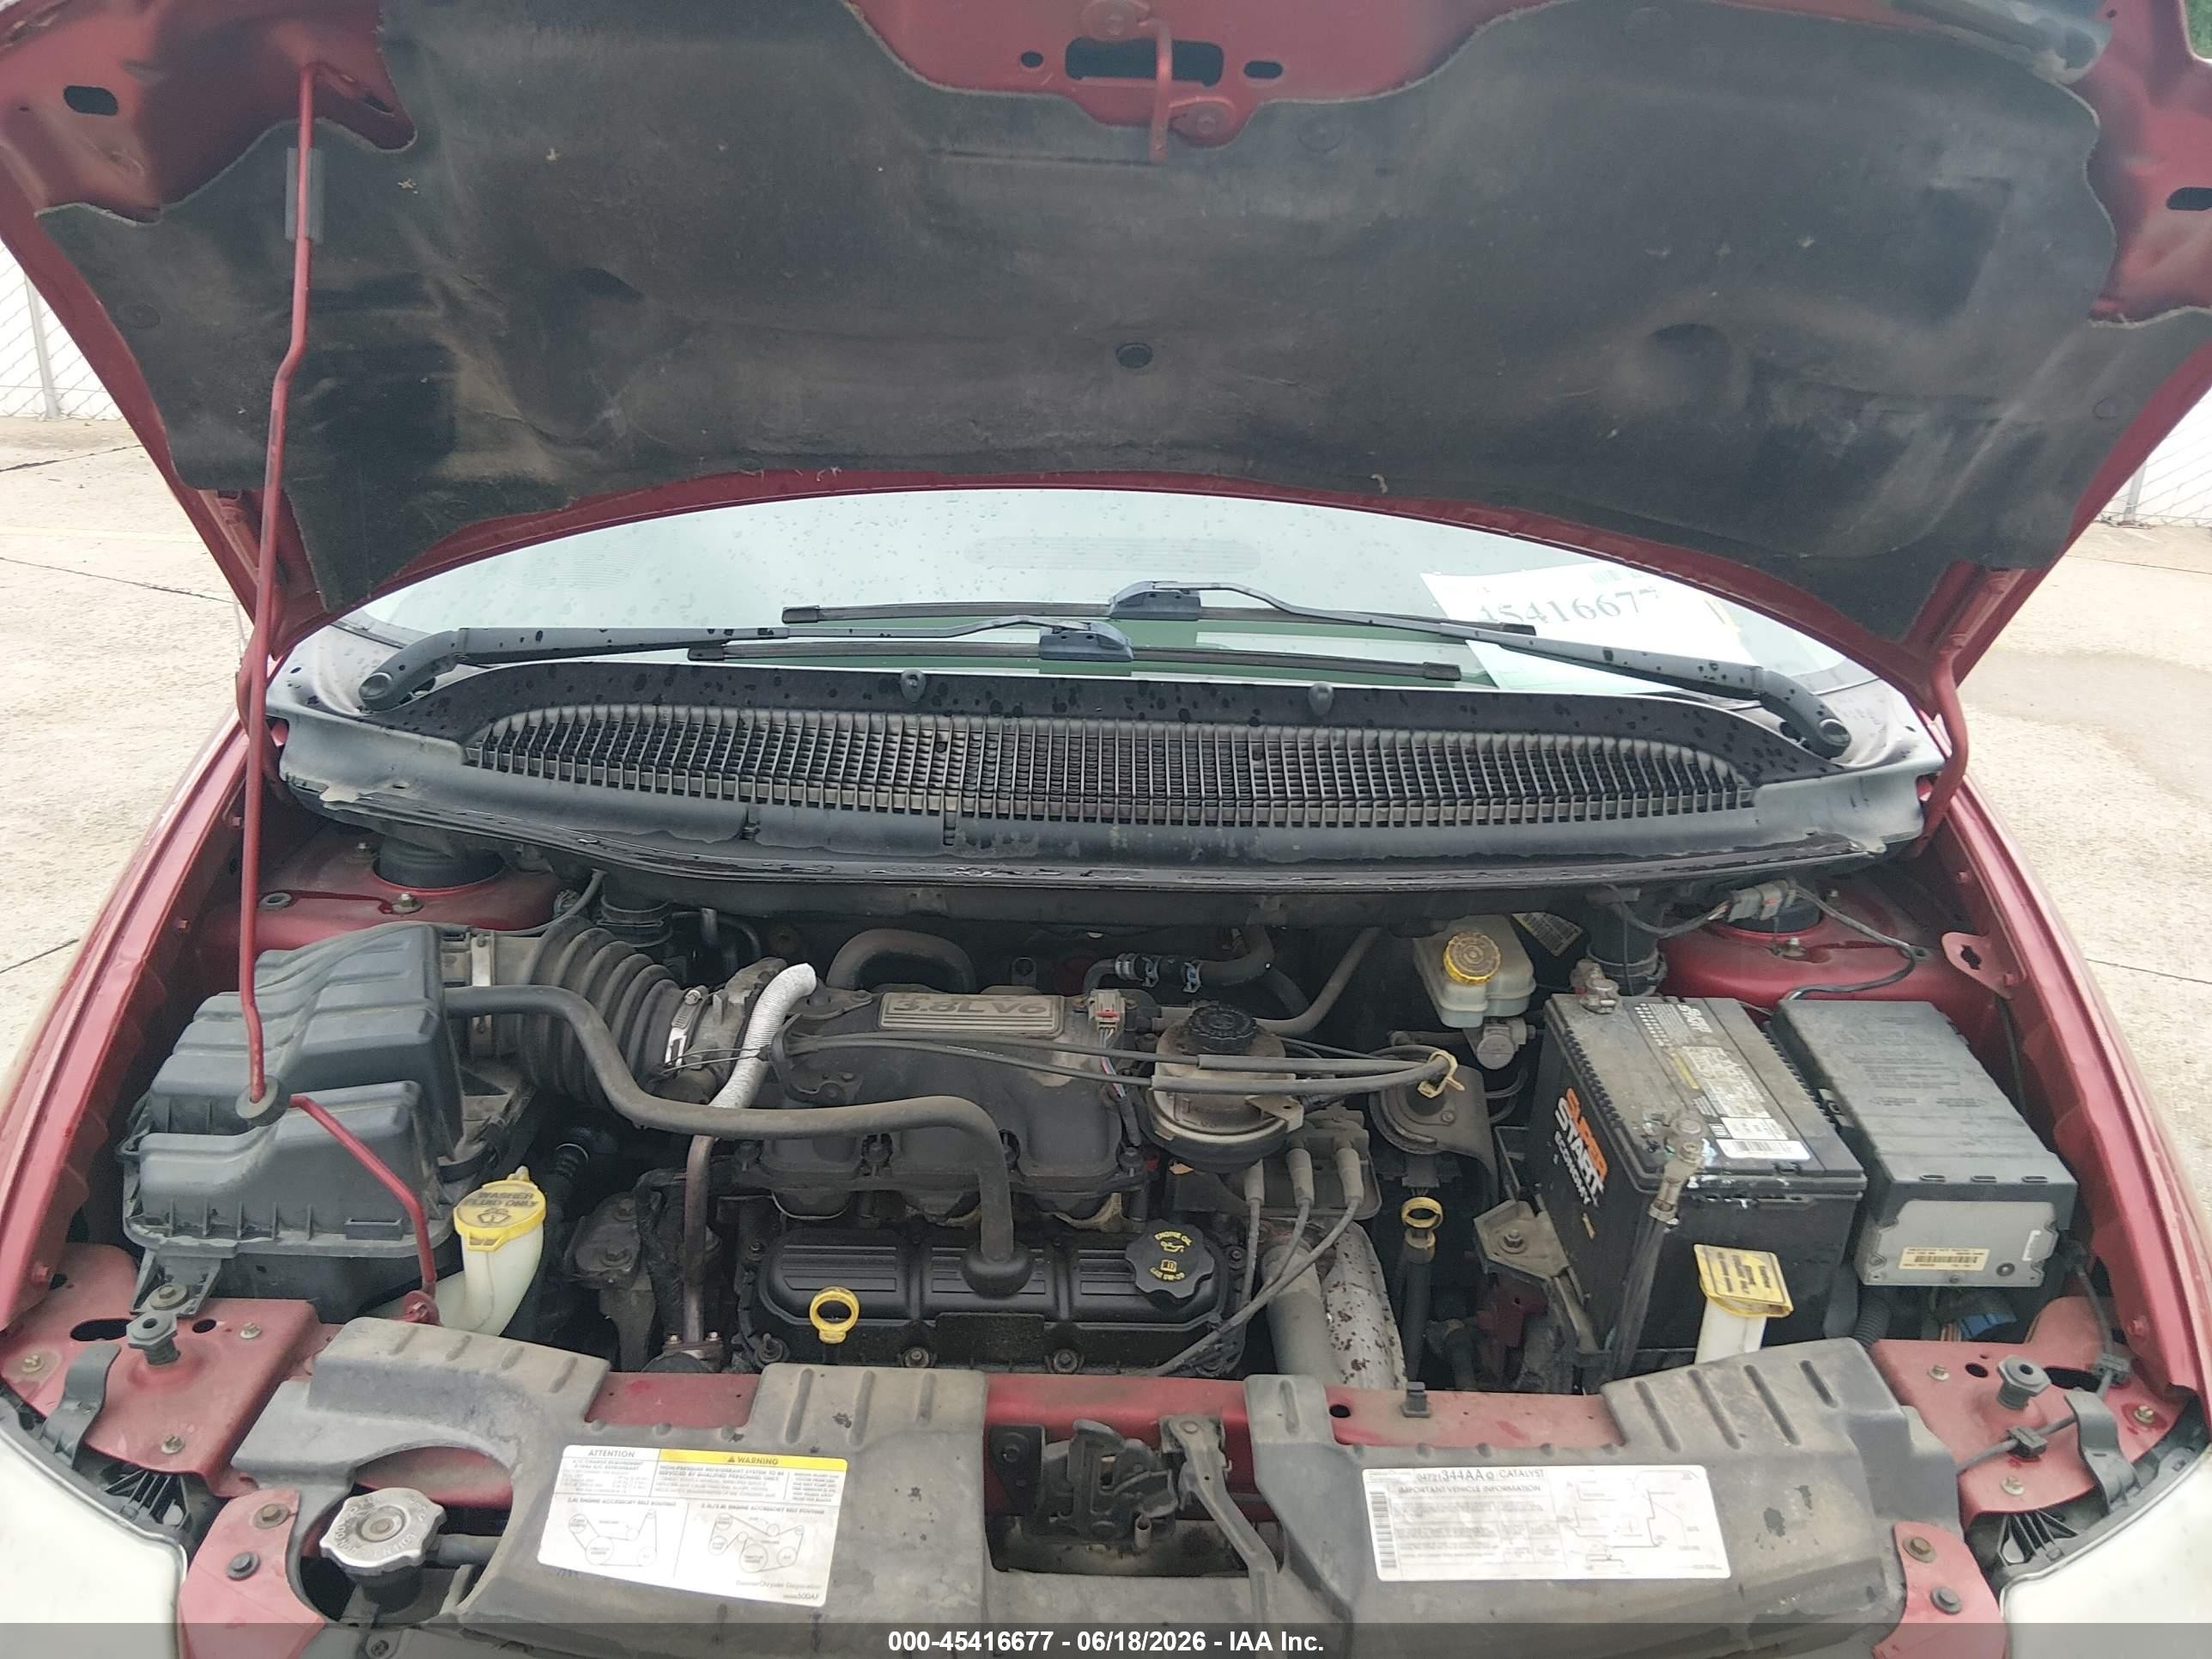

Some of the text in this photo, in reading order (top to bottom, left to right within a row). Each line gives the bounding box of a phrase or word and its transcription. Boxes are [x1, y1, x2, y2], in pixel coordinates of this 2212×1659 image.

[1565, 1087, 1607, 1182] SUPER
[1555, 1097, 1605, 1207] START
[1553, 1130, 1591, 1205] ECONOMY
[1154, 1231, 1193, 1246] ENGINE OIL
[587, 1449, 636, 1458] ATTENTION
[737, 1456, 779, 1466] WARNING
[1498, 1469, 1545, 1478] CATALYST
[1399, 1486, 1446, 1494] IMPORTANT
